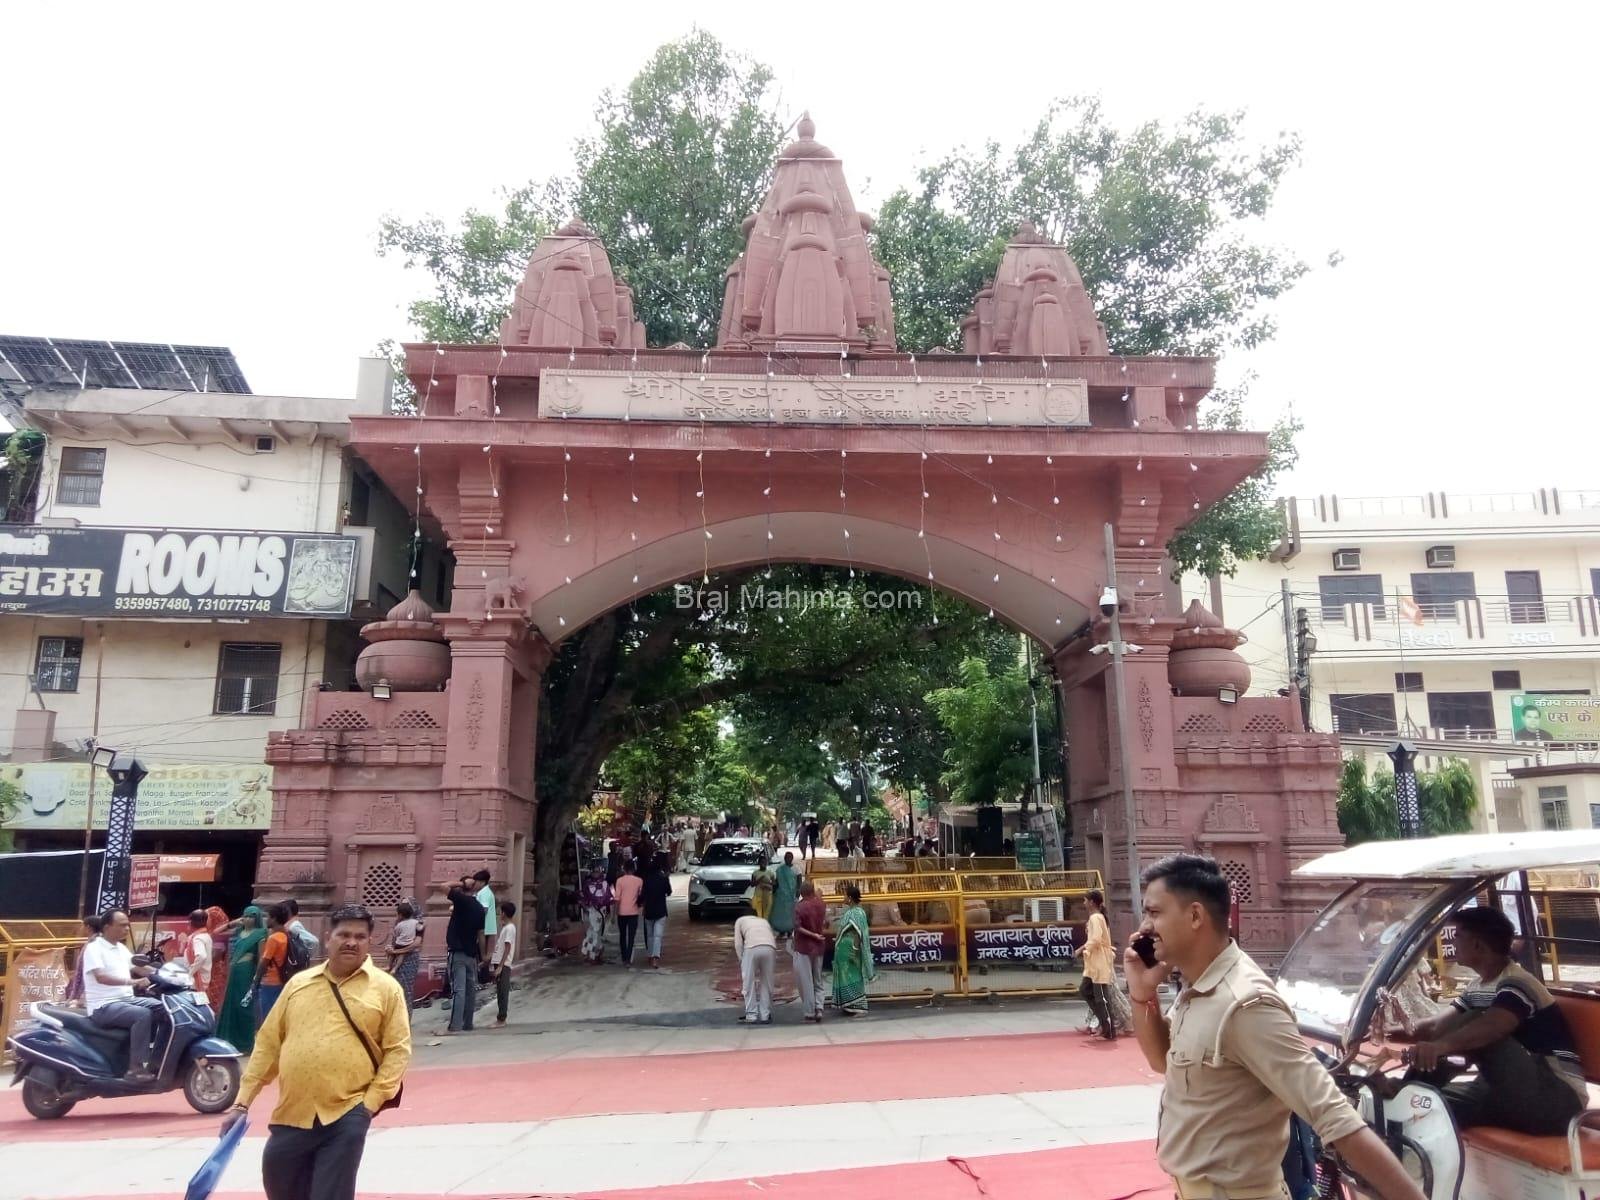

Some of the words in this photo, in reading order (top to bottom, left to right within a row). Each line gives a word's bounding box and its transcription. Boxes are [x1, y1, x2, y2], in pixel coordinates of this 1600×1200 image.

[115, 533, 287, 597] ROOMS
[115, 597, 193, 612] 9359957480,
[197, 599, 271, 612] 7310775748
[900, 930, 944, 950] पुलिस
[974, 928, 1034, 944] यातायात
[1035, 925, 1073, 944] पुलिस
[881, 951, 913, 964] मथुरा
[1013, 945, 1044, 959] मथुरा
